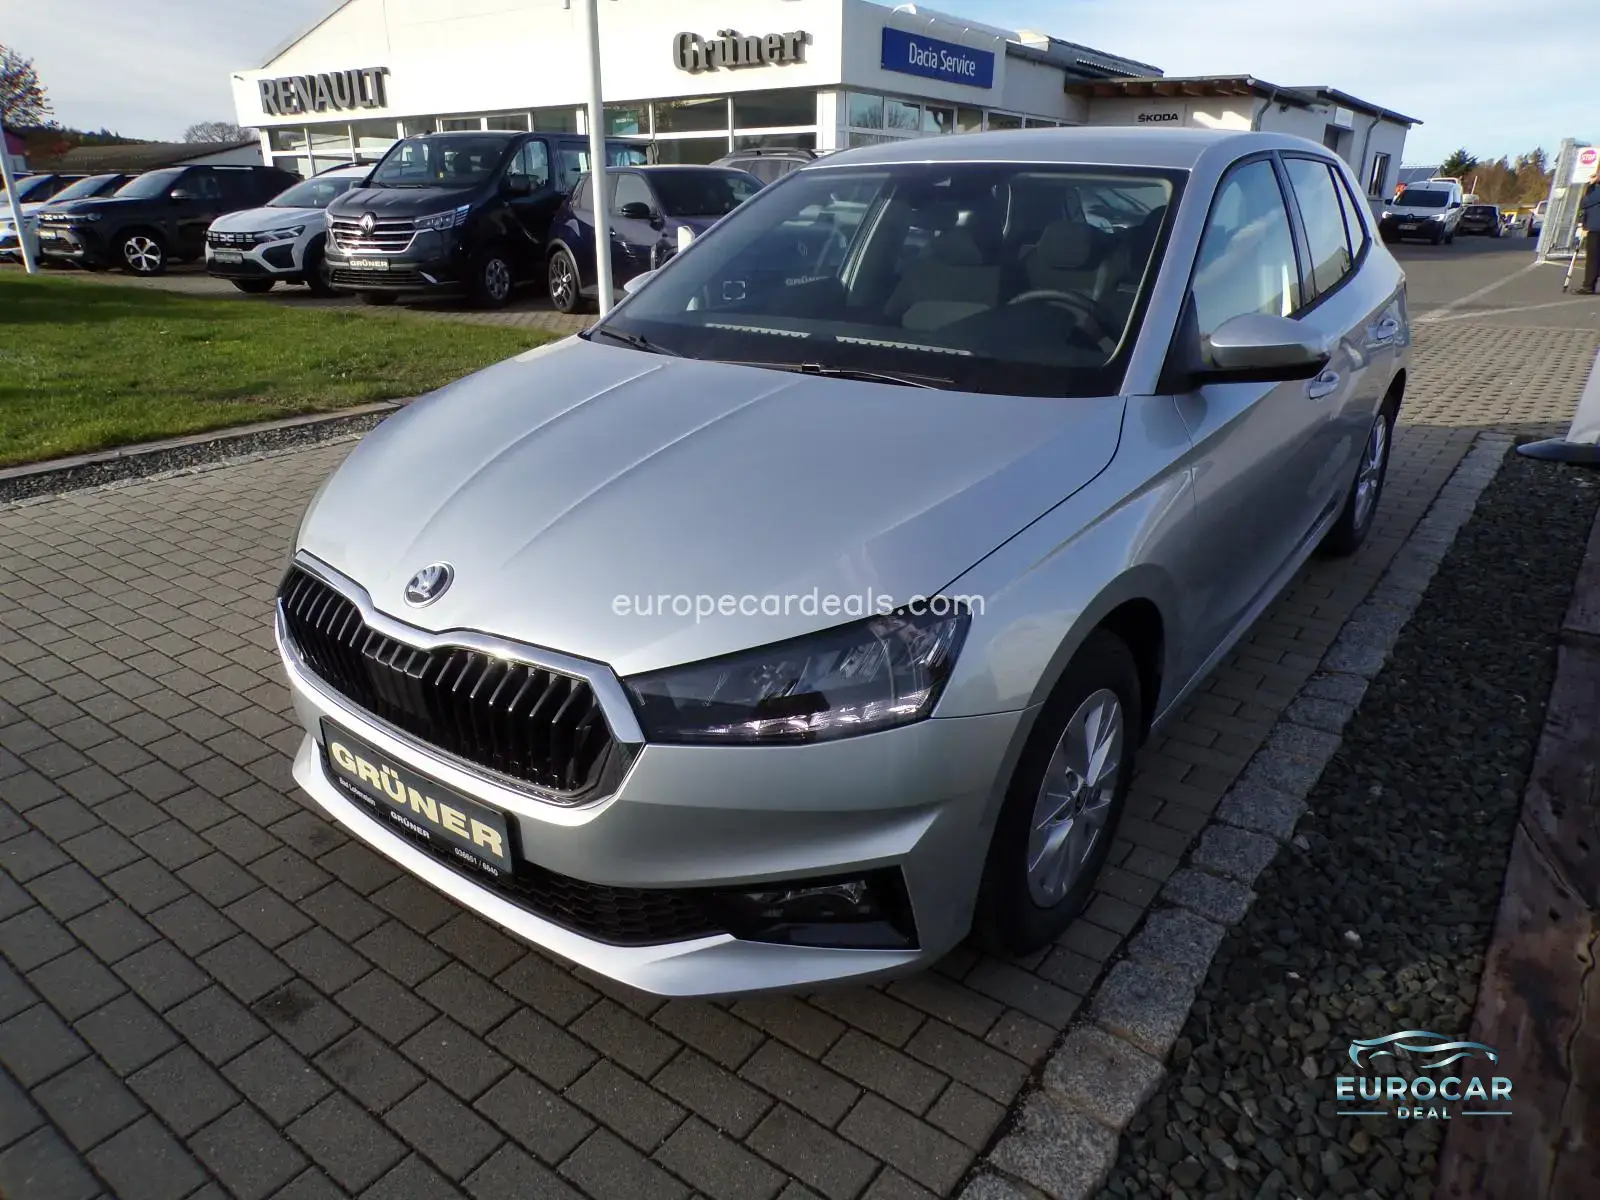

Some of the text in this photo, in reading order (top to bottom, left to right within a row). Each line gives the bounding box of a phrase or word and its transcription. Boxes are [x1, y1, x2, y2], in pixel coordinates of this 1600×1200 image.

[672, 28, 813, 74] Grüner
[908, 41, 976, 77] Dacia Service
[257, 66, 391, 116] RENAULT
[1137, 112, 1179, 123] ŠKODA
[350, 258, 388, 267] GRÜNER
[331, 742, 504, 857] GRÜNER
[390, 810, 431, 839] GRÜNER
